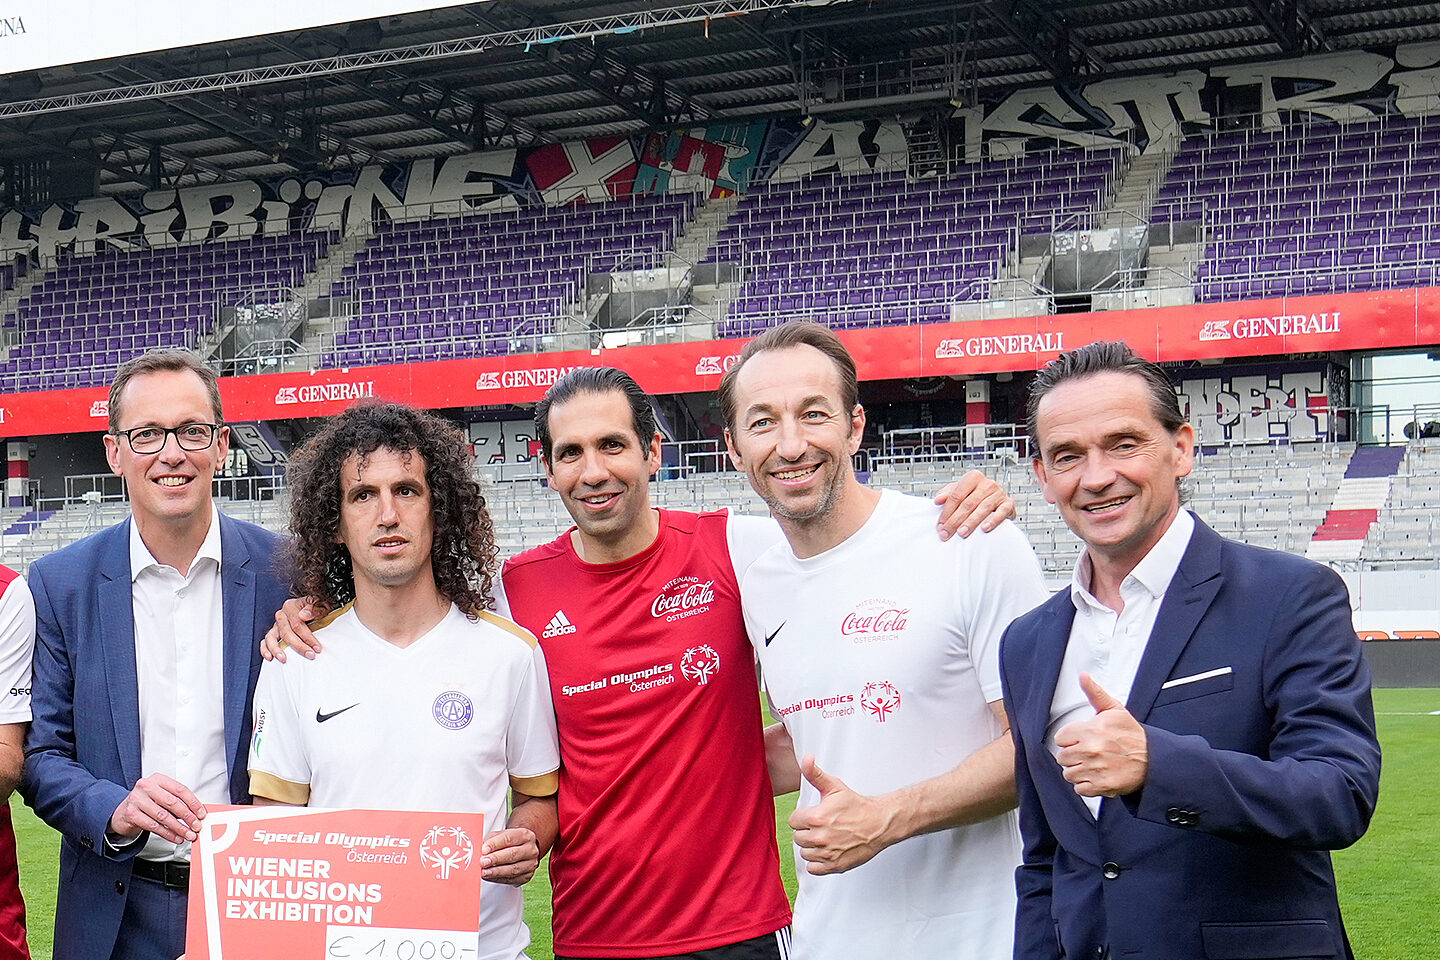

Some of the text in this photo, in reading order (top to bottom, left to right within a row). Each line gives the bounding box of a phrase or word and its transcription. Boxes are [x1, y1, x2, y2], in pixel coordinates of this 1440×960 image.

[1233, 312, 1340, 338] GENERALI
[965, 332, 1063, 356] GENERALI
[298, 382, 373, 403] GENERALI
[651, 580, 715, 617] Coca-Cola
[542, 624, 576, 638] adidas
[841, 608, 911, 635] Coca-Cola
[562, 663, 674, 696] Special Olympics
[630, 674, 675, 692] Österreich
[805, 694, 854, 709] Olympics
[253, 830, 410, 849] Special Olympics
[228, 856, 330, 879] WIENER
[346, 848, 408, 864] Österreich
[227, 878, 382, 903] INKLUSIONS
[225, 900, 373, 925] EXHIBITION
